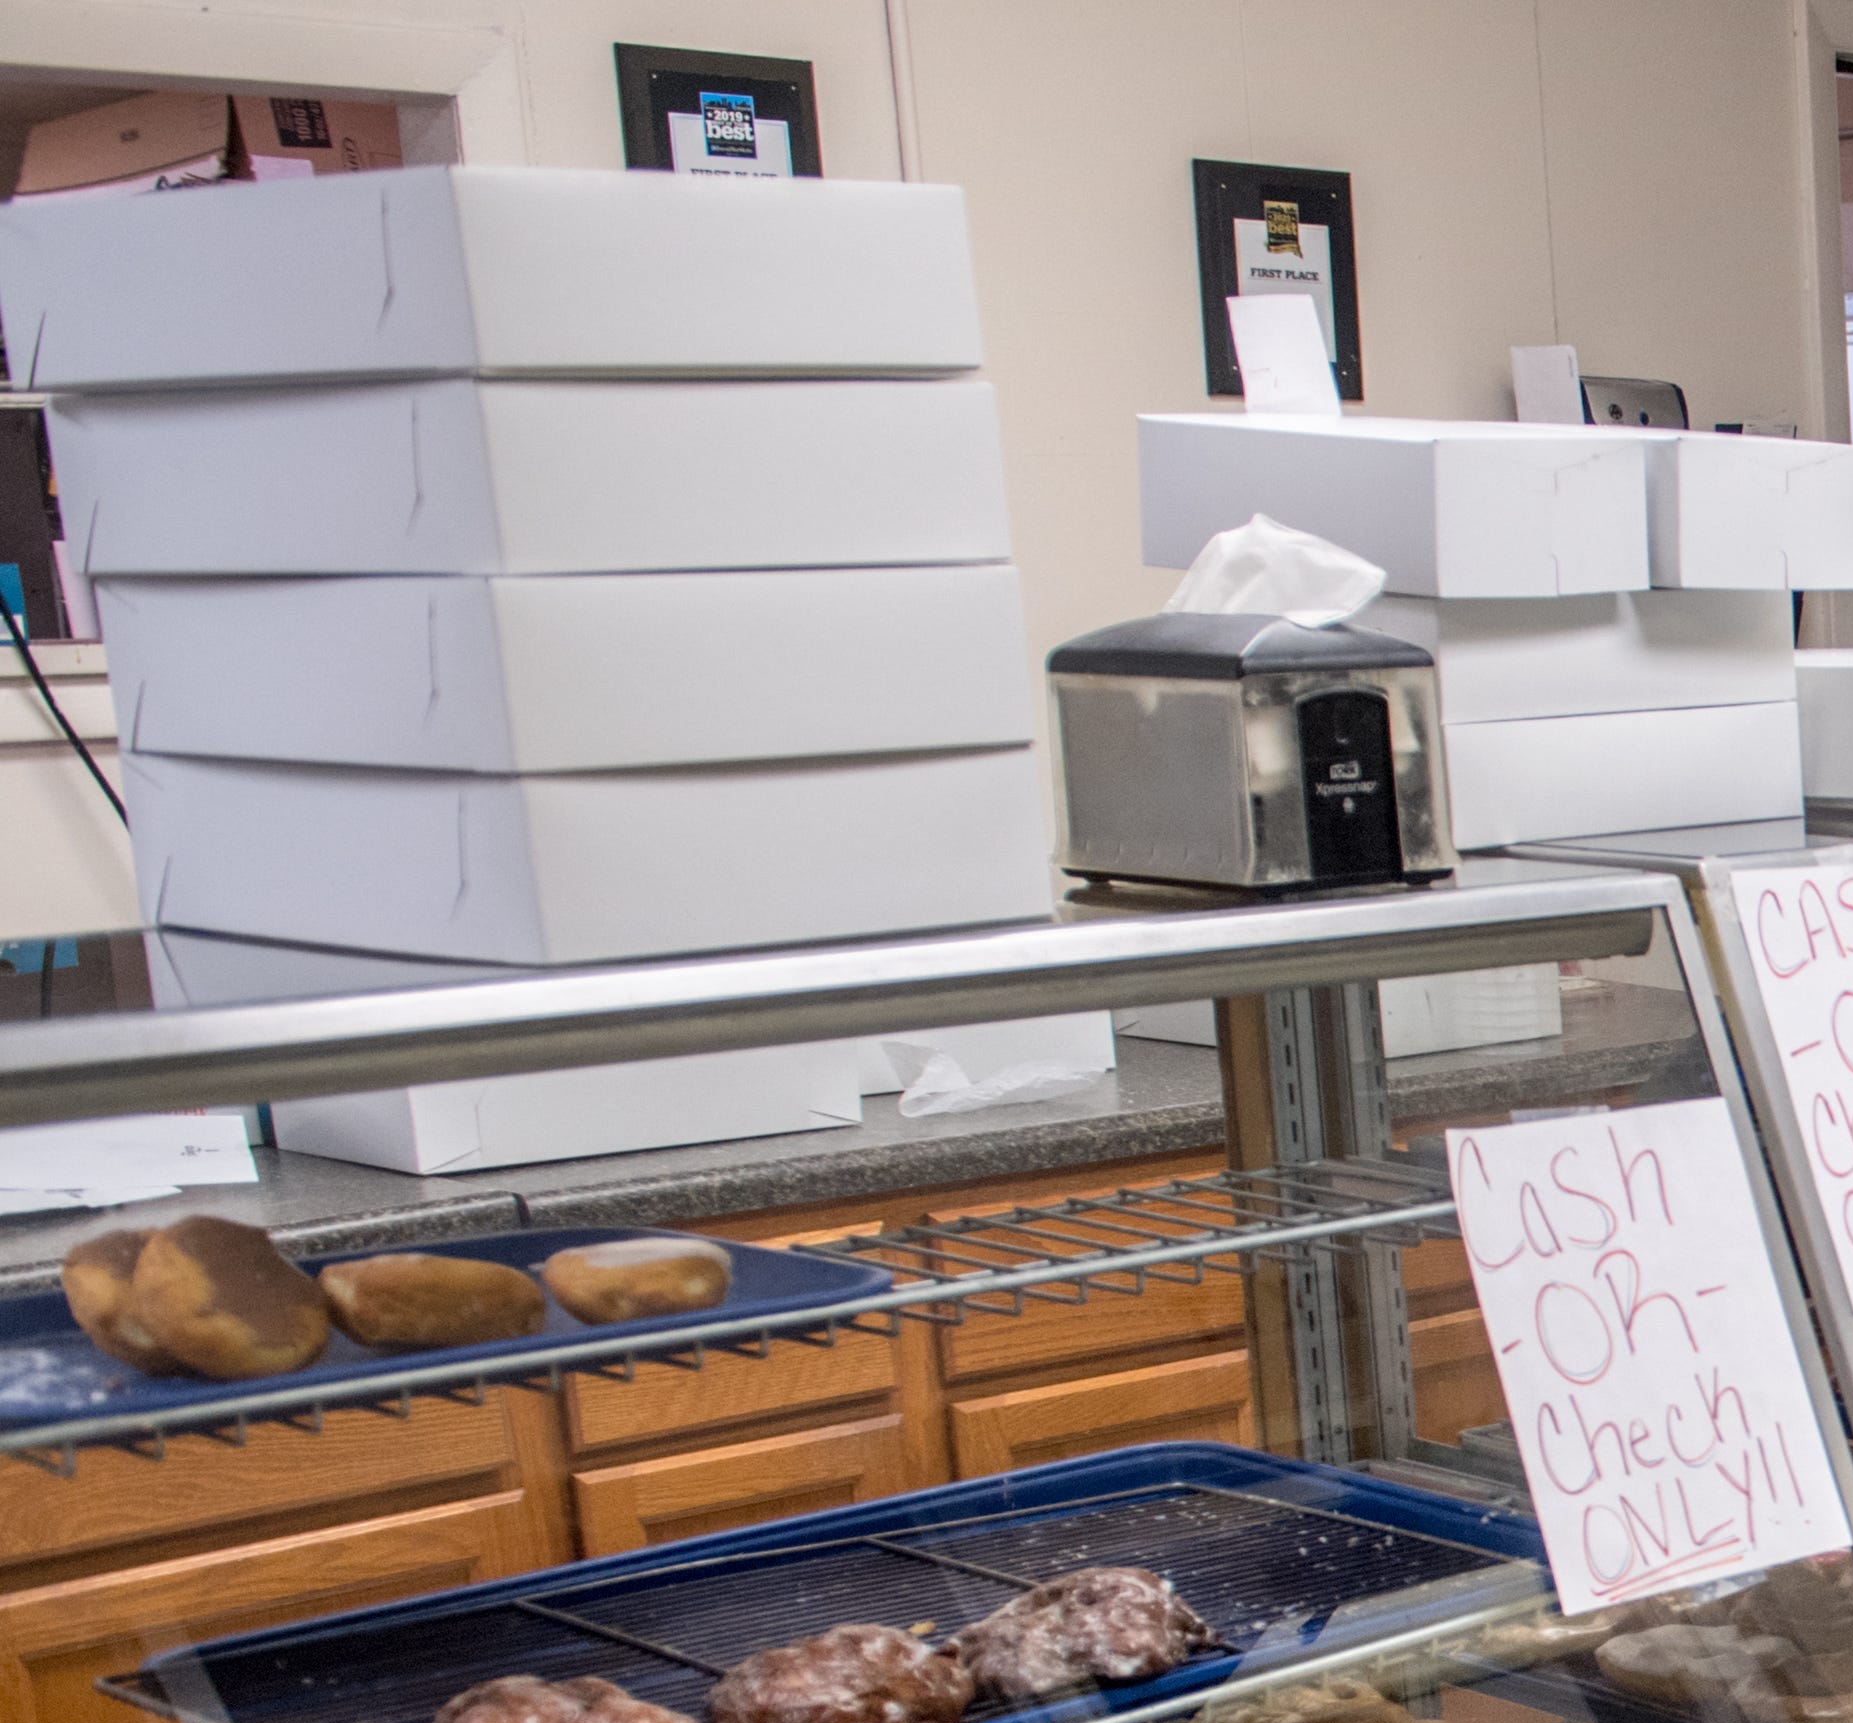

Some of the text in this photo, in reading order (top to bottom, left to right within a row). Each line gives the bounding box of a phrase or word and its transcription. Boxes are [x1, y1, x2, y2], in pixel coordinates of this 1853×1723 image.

[713, 110, 743, 122] 2019
[705, 120, 755, 141] best
[1250, 267, 1319, 281] FIRST PLACE
[1537, 1366, 1752, 1495] Check
